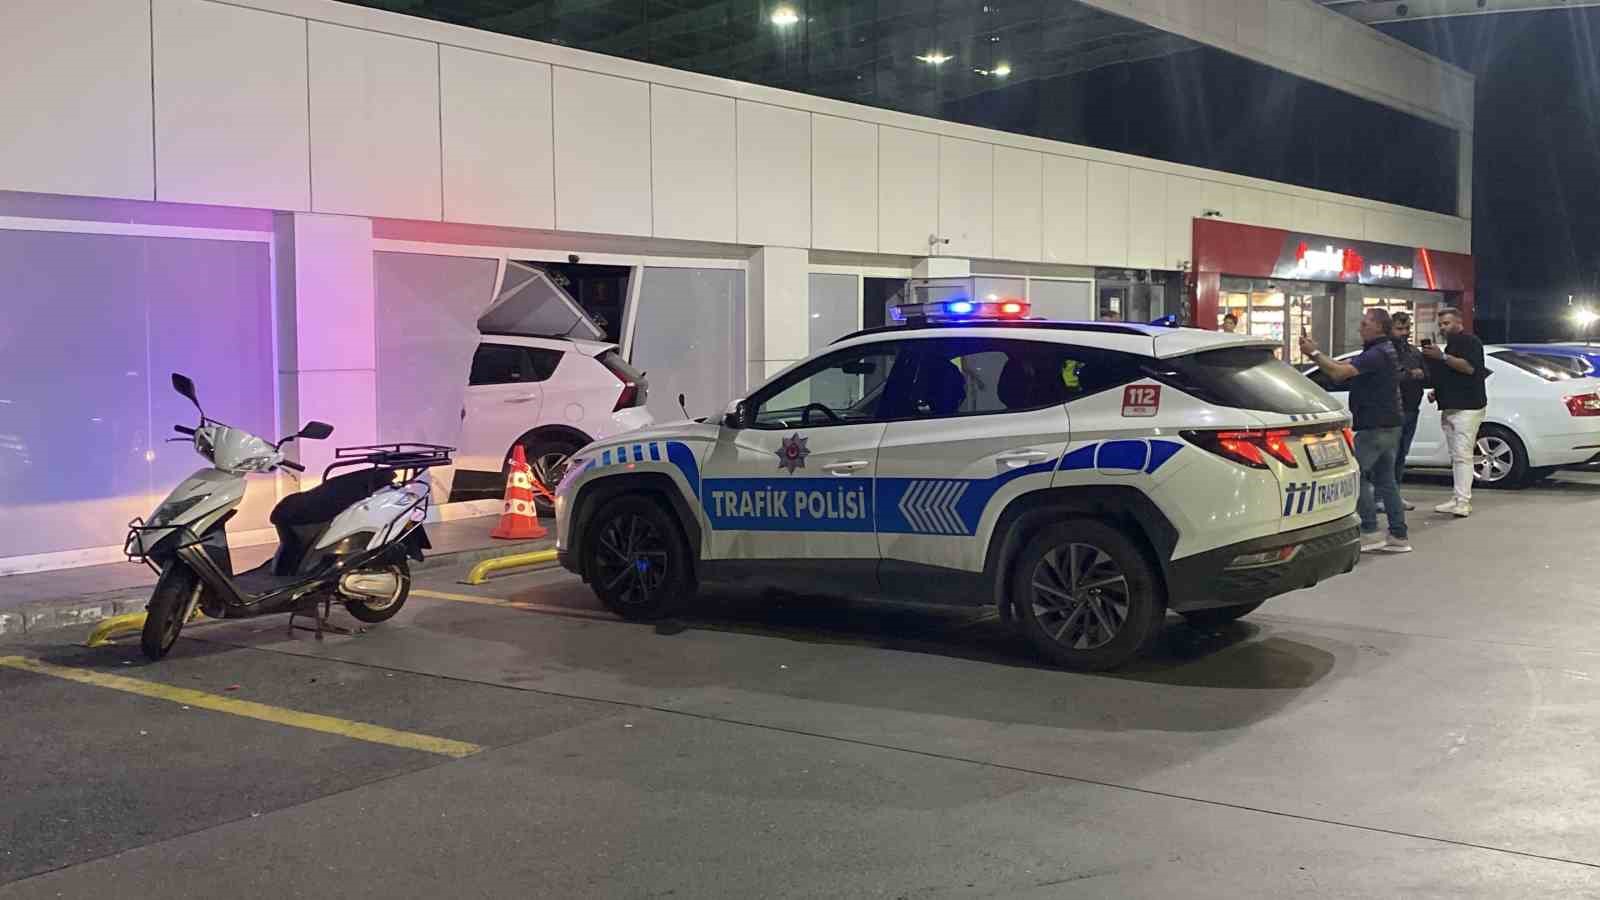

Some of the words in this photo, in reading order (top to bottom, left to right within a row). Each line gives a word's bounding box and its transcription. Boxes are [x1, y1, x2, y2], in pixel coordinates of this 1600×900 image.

[1129, 388, 1155, 405] 112
[711, 486, 789, 517] TRAFİK
[794, 486, 866, 519] POLİSİ
